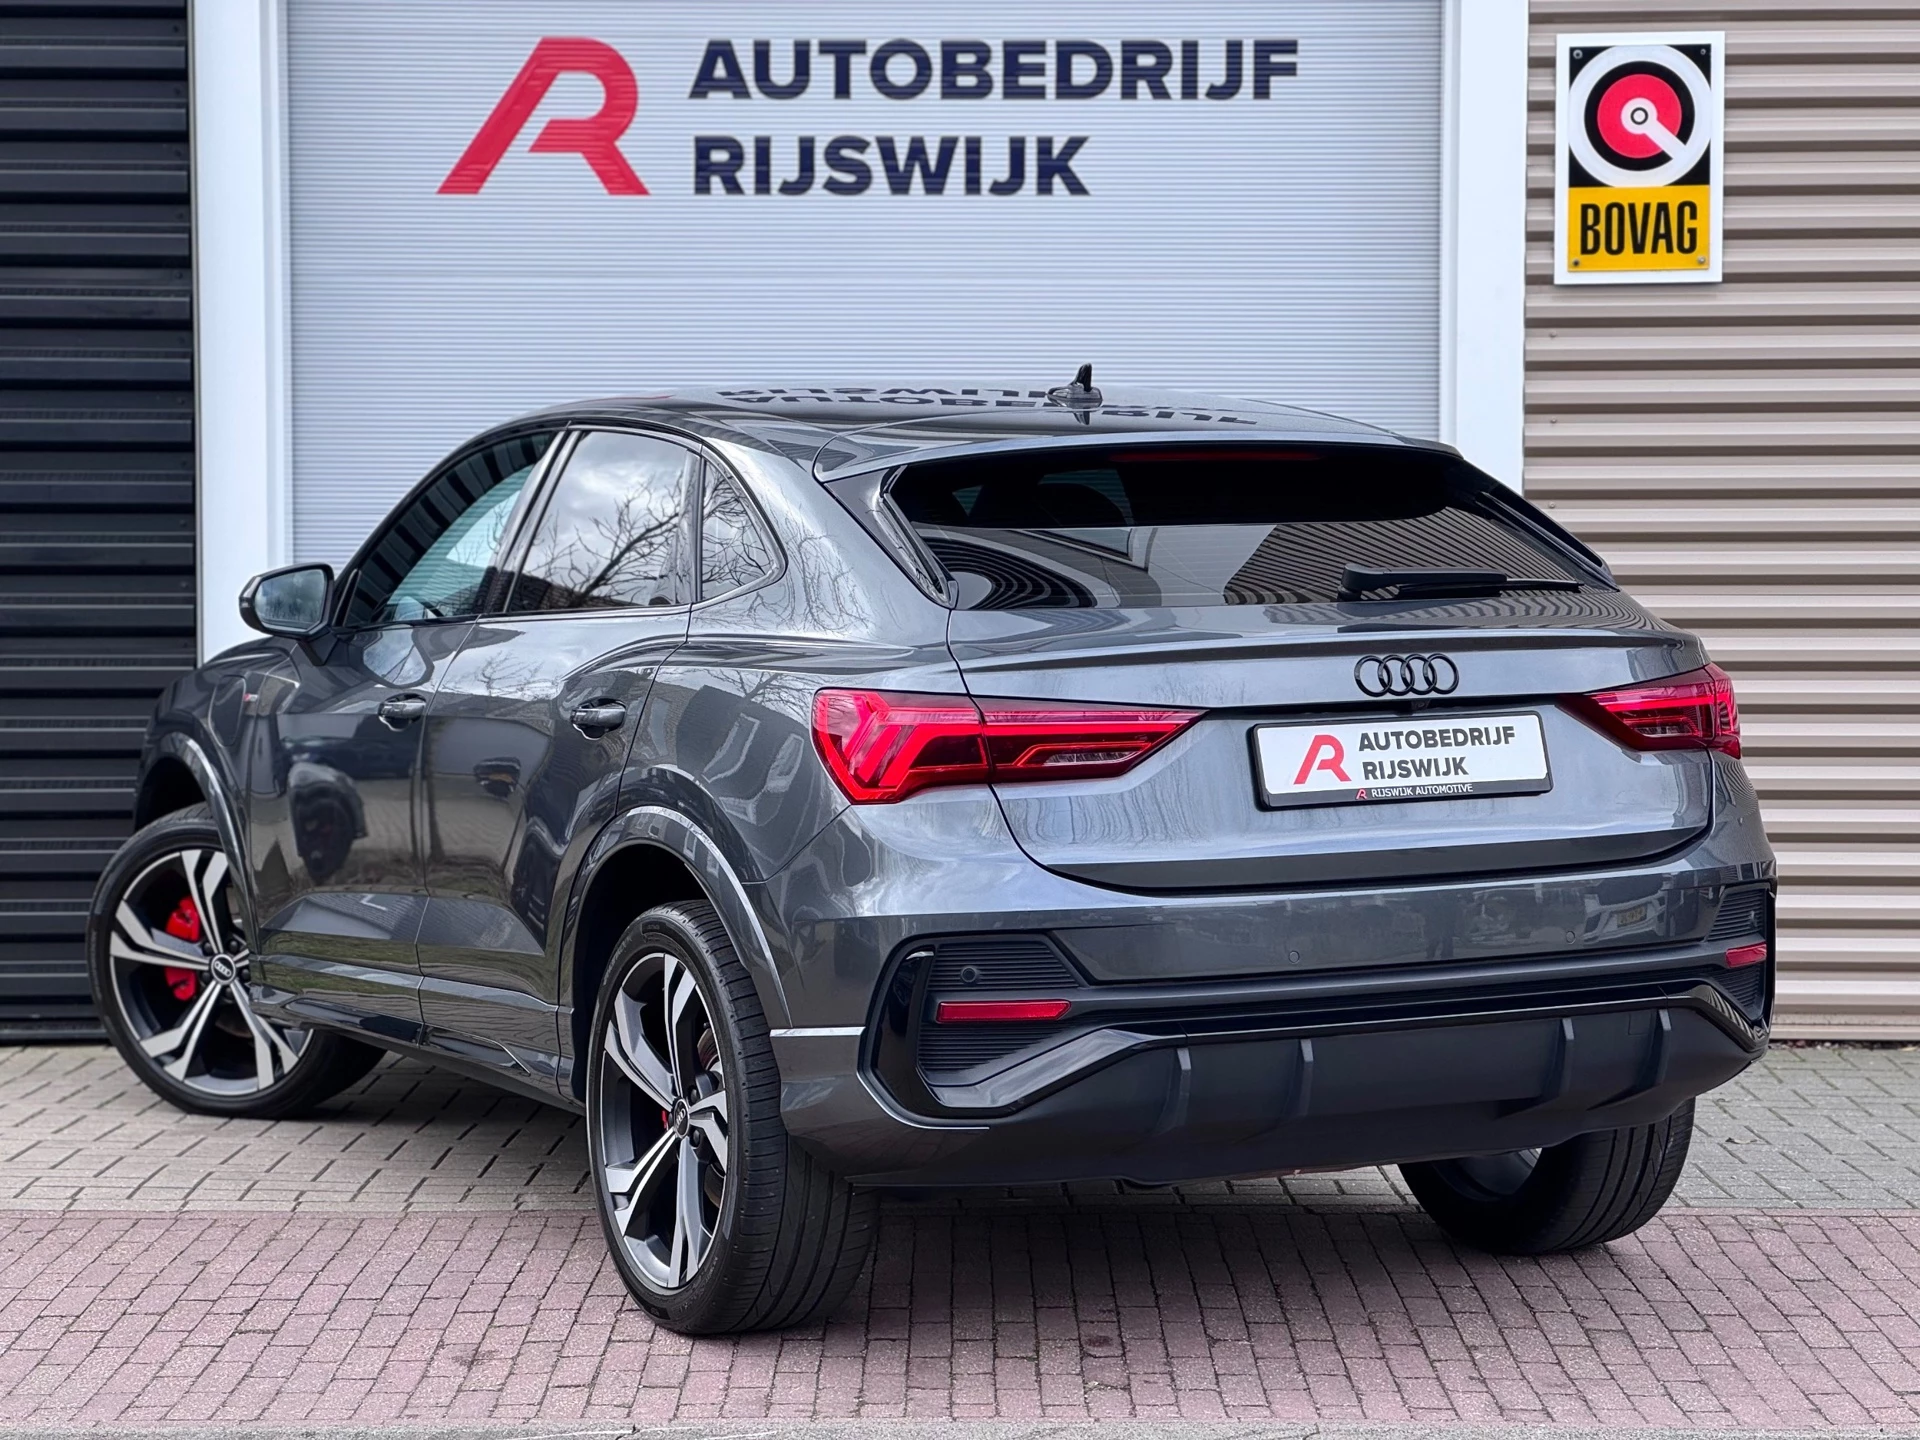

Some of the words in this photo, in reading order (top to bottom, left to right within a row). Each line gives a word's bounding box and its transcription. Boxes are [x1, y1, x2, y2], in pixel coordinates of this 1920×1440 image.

[688, 39, 1298, 101] AUTOBEDRIJF
[694, 135, 1090, 196] RIJSWIJK
[1580, 200, 1698, 256] BOVAG
[1359, 726, 1515, 751] AUTOBEDRIJF
[1362, 756, 1469, 780] RIJSWIJK
[1371, 786, 1413, 798] RIJSWIJK
[1415, 783, 1474, 796] AUTOMOTIVE
